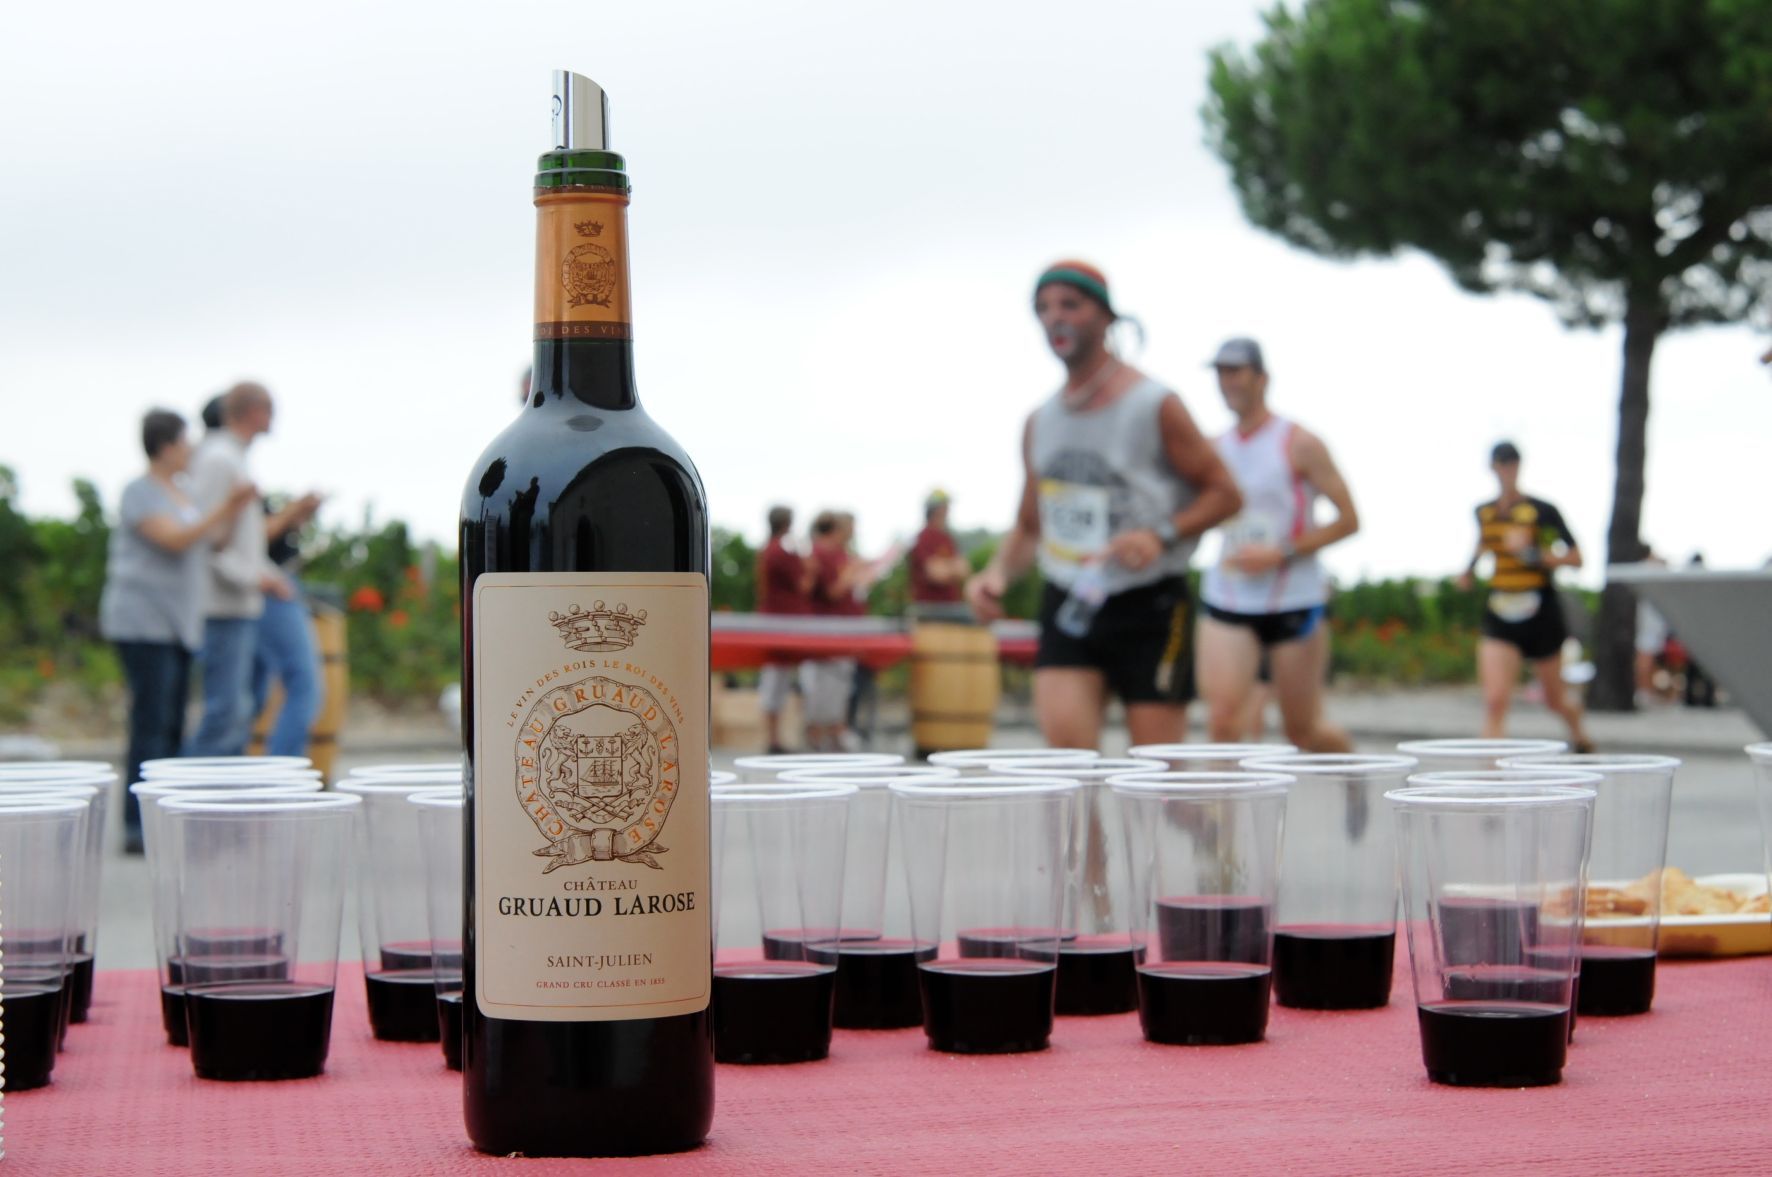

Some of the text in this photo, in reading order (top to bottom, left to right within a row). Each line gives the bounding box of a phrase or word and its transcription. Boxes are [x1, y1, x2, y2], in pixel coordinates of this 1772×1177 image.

[561, 326, 590, 334] DES
[507, 659, 684, 728] LE VIN DES ROIS LE ROI DES VINS
[552, 684, 657, 721] GRUAUD
[627, 735, 678, 844] LAROSE
[563, 876, 638, 891] CHÂTEAU
[498, 892, 695, 917] GRUAUD LAROSE
[547, 953, 653, 970] SAINT-JULIEN
[536, 981, 570, 989] GRAND
[573, 981, 594, 989] CRU
[634, 978, 647, 987] EN
[650, 977, 665, 986] 1855
